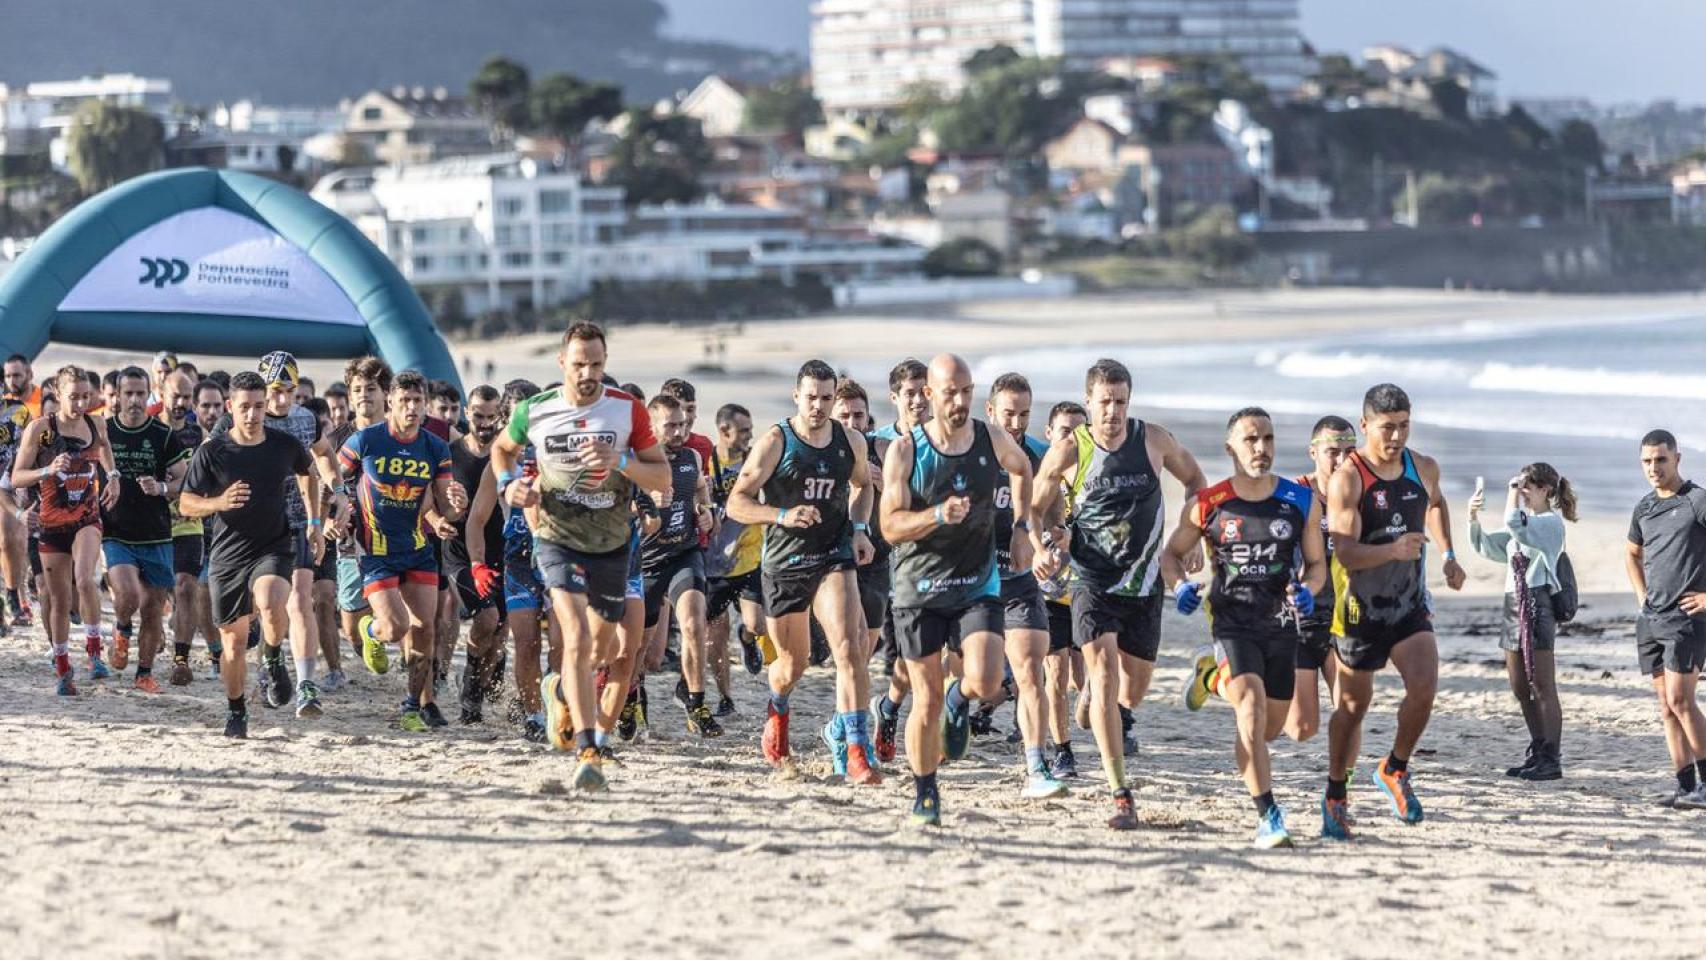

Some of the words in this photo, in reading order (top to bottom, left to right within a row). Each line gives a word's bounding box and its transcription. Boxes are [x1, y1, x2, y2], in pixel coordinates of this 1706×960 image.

[199, 263, 289, 277] Deputación
[198, 273, 289, 289] Pontevedra
[374, 456, 431, 479] 1822
[804, 477, 835, 500] 377
[1240, 565, 1267, 575] OCR
[1348, 595, 1359, 625] ESP
